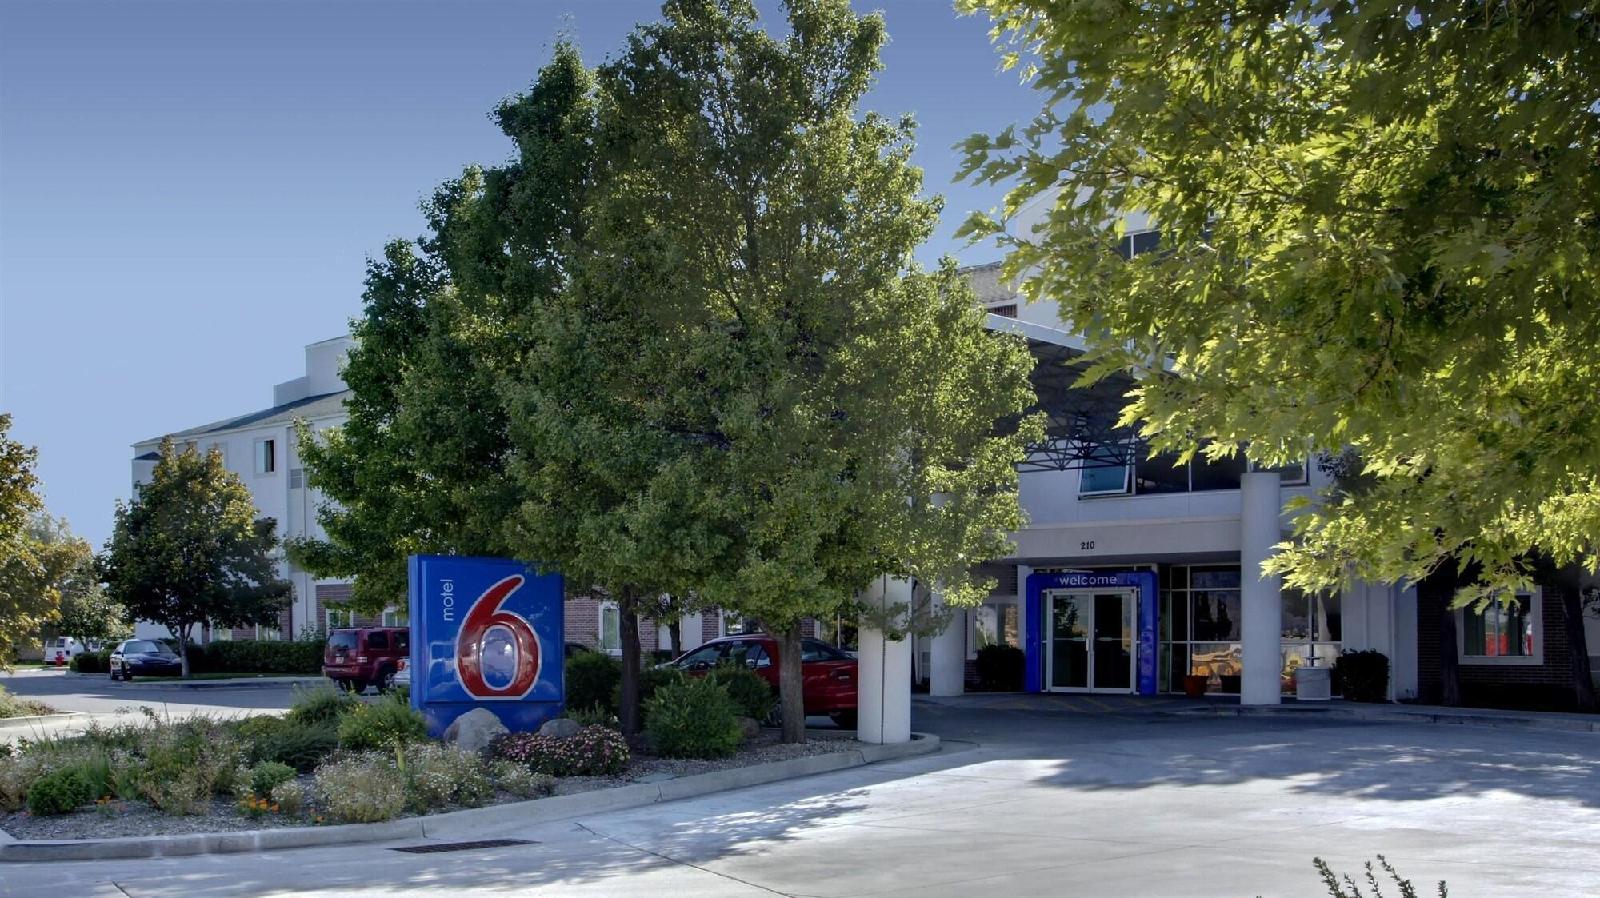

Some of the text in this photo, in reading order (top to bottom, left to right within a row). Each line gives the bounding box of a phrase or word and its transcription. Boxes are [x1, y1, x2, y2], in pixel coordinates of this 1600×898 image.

[1080, 541, 1095, 550] 210
[1059, 575, 1118, 586] welcome
[440, 579, 454, 621] motel
[455, 574, 542, 700] 6
